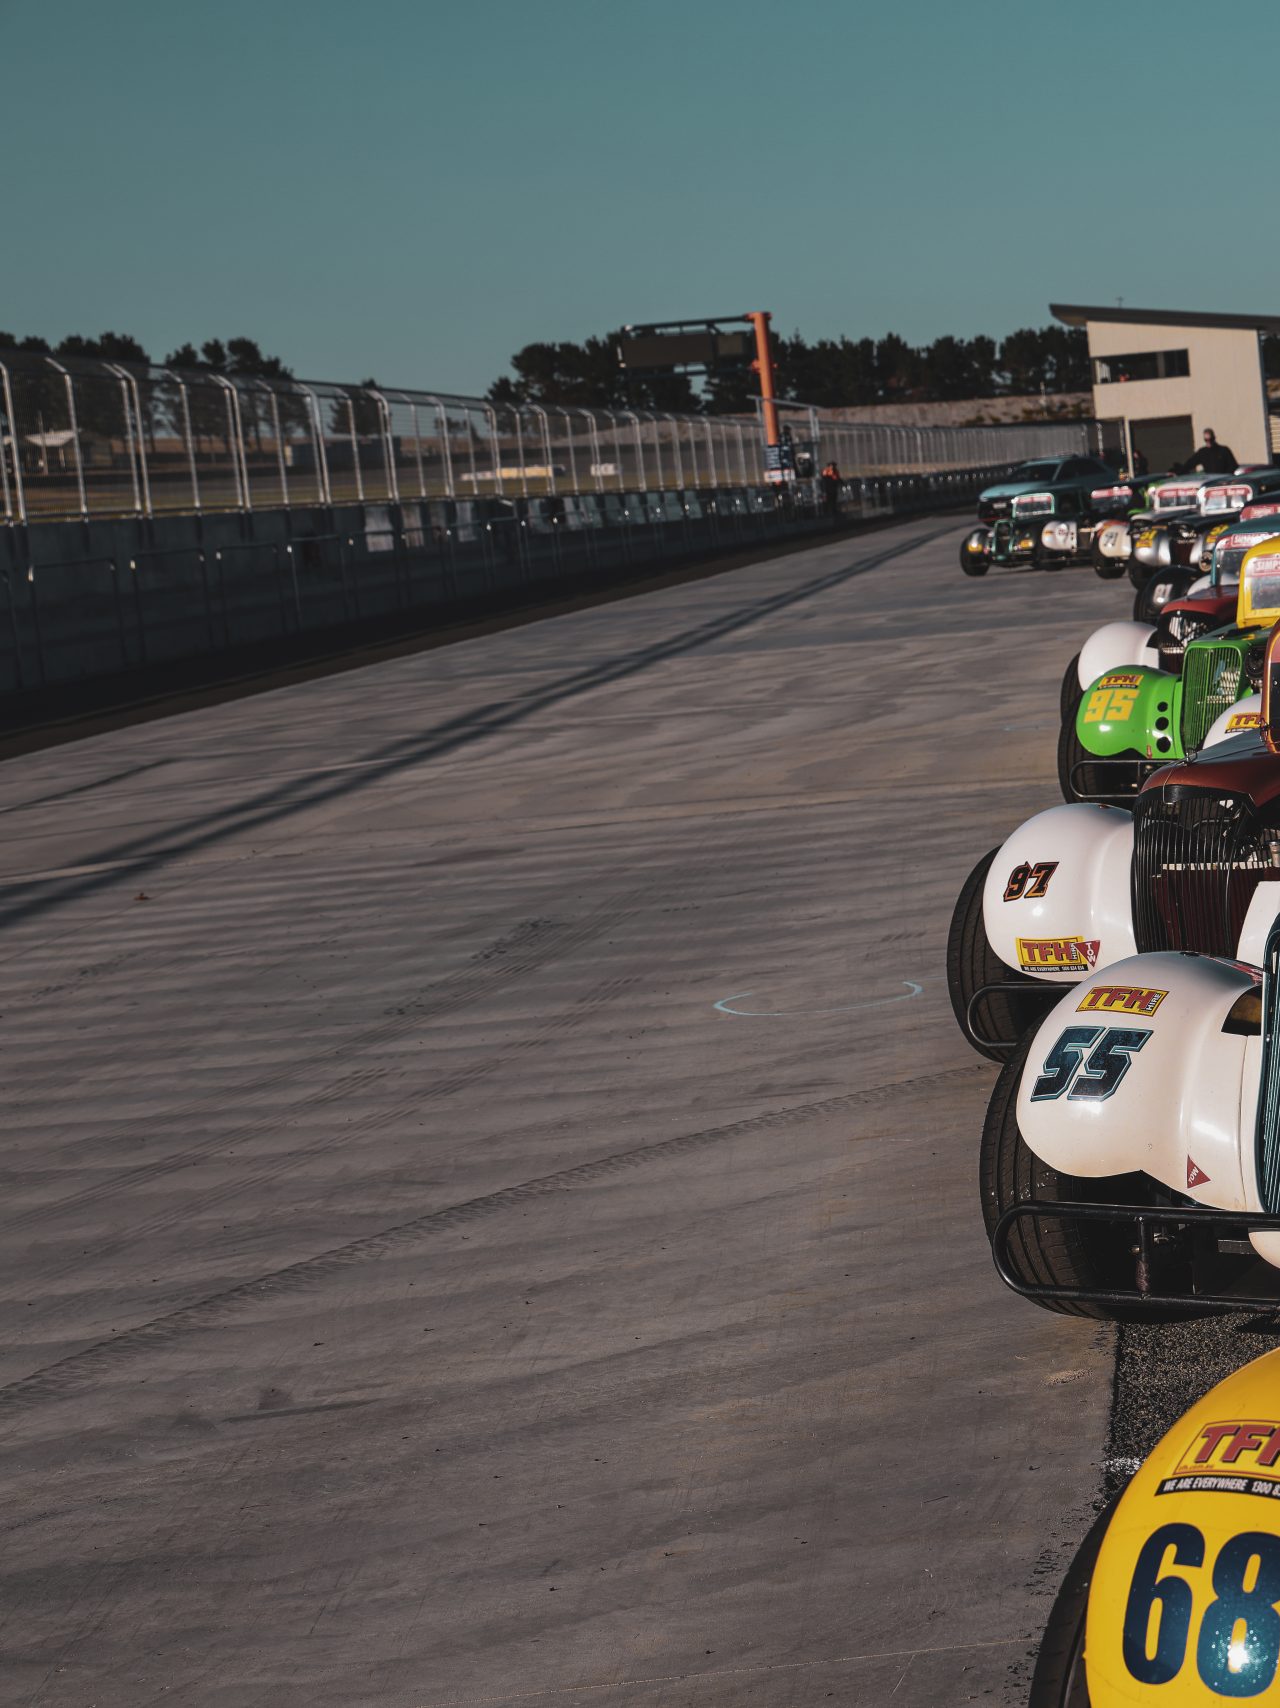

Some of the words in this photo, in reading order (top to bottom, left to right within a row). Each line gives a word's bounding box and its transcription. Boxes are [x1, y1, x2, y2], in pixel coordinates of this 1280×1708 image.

[1083, 689, 1139, 724] 95
[1003, 861, 1060, 901] 97
[1022, 941, 1073, 962] TFH
[1085, 942, 1097, 963] TOW
[1087, 987, 1156, 1010] TFH
[1145, 993, 1162, 1012] HIRE
[1030, 1025, 1155, 1103] 55
[1188, 1166, 1200, 1184] TOW
[1163, 1479, 1175, 1492] WE
[1175, 1478, 1192, 1490] ARE
[1192, 1477, 1249, 1491] EVERYWHERE
[1251, 1480, 1273, 1495] 1300
